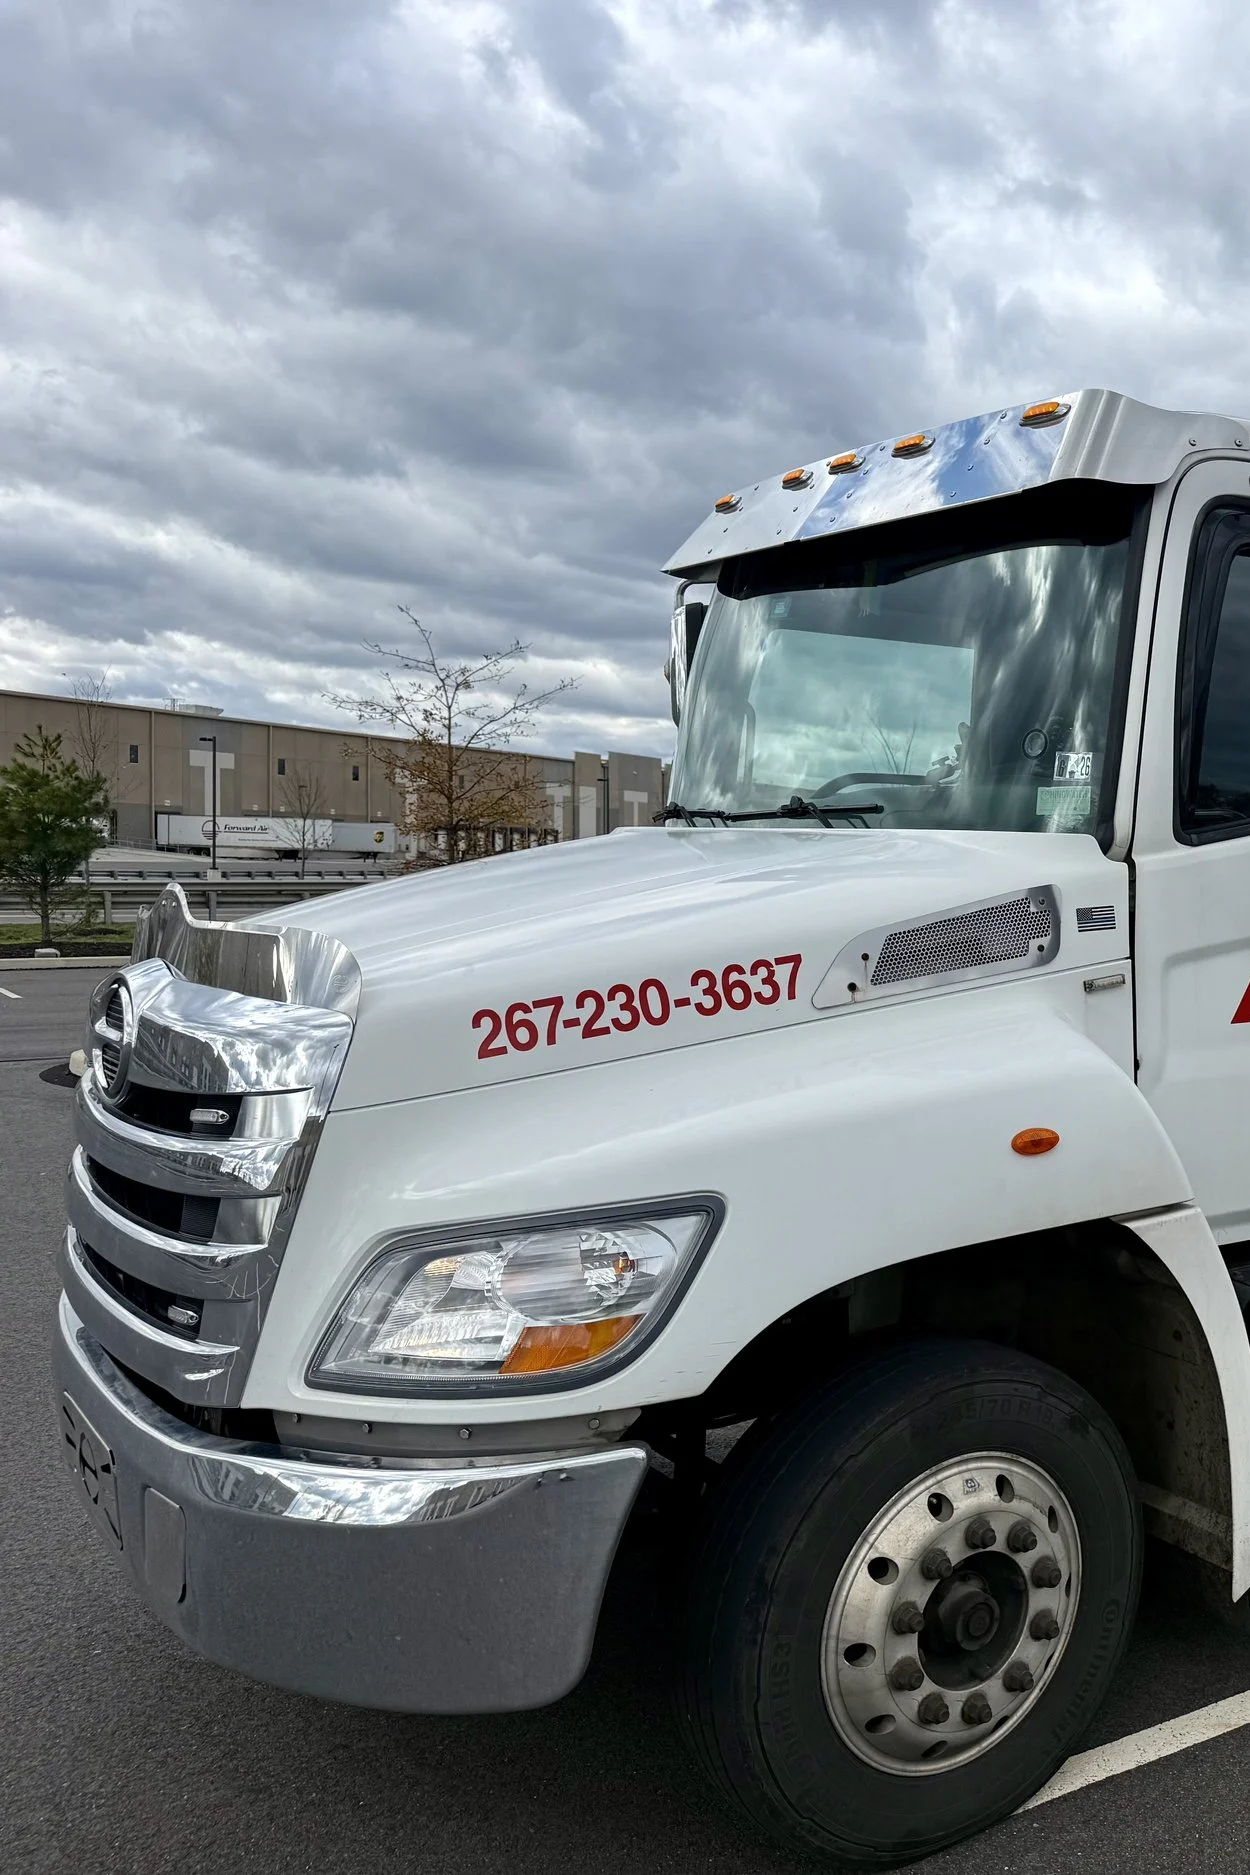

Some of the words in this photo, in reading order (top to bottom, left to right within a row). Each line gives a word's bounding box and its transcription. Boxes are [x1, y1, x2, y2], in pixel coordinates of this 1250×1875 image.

[1080, 756, 1090, 776] 26
[223, 823, 256, 832] Forward
[257, 824, 269, 832] Air
[472, 953, 802, 1060] 267-230-3637
